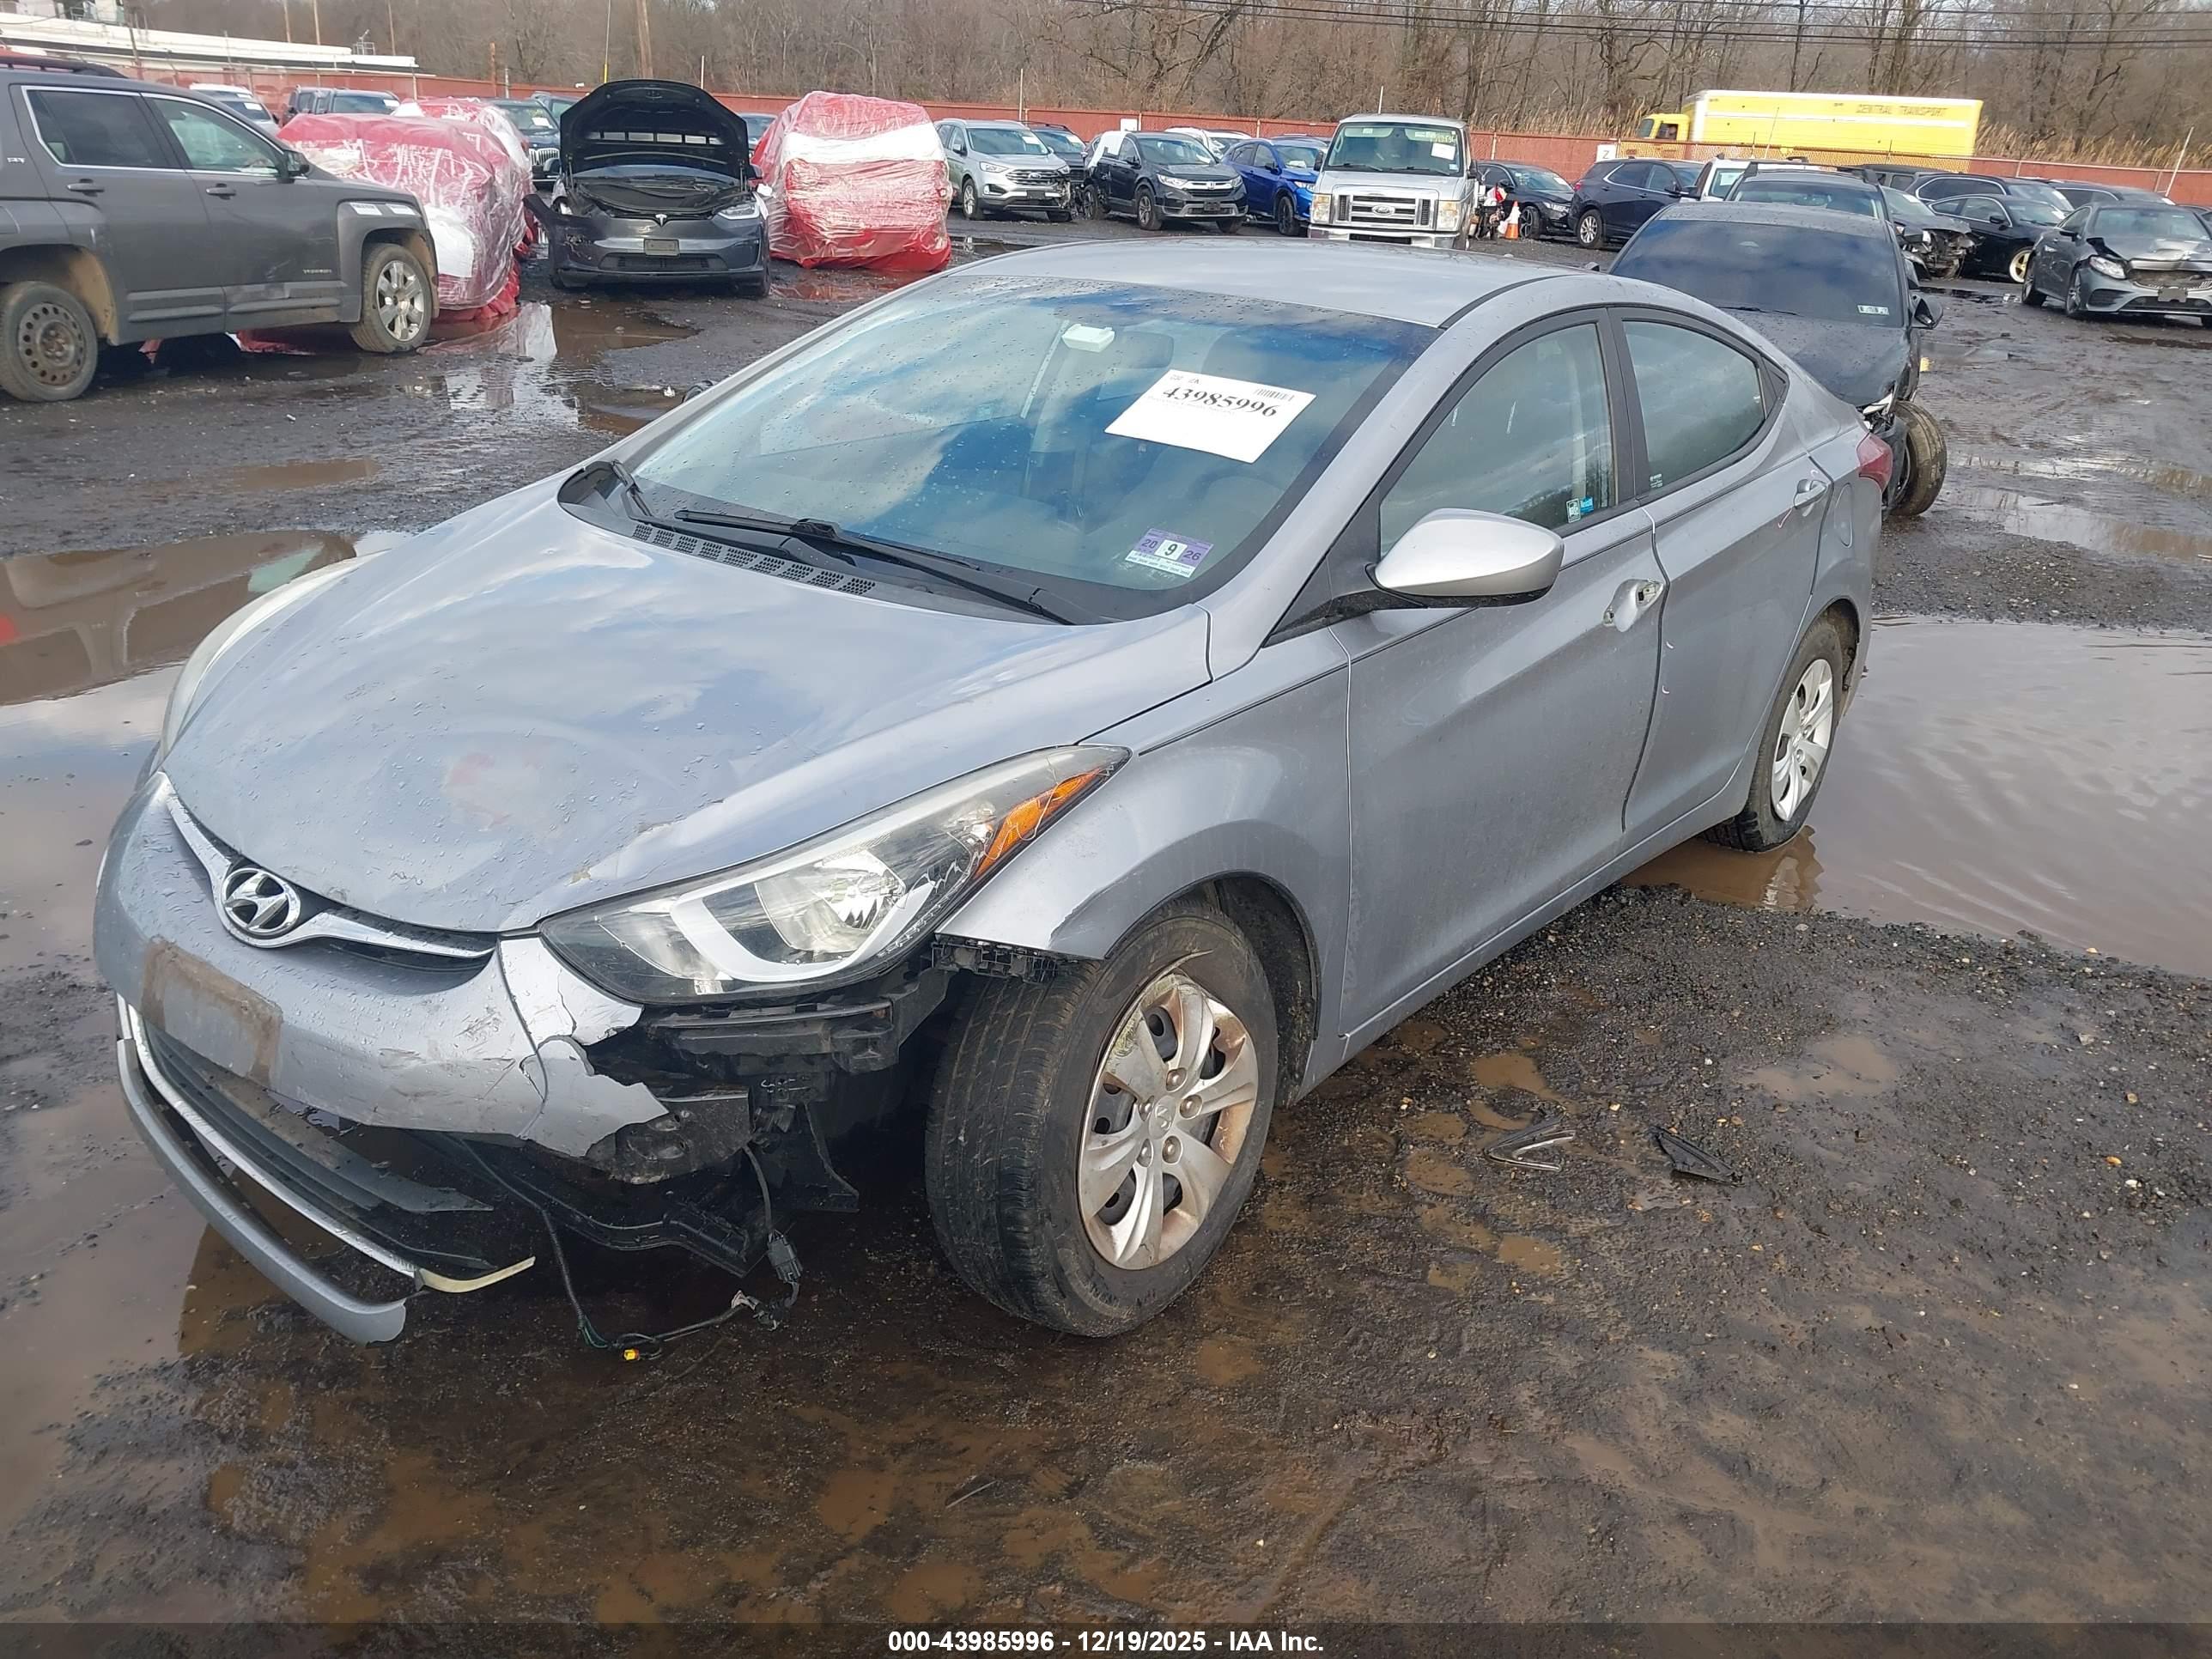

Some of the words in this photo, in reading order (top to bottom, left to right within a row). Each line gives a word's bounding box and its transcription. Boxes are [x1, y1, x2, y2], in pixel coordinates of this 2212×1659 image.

[1163, 386, 1279, 417] 43985996
[1141, 538, 1158, 550] 20
[1164, 544, 1178, 556] 9
[1183, 550, 1202, 561] 26
